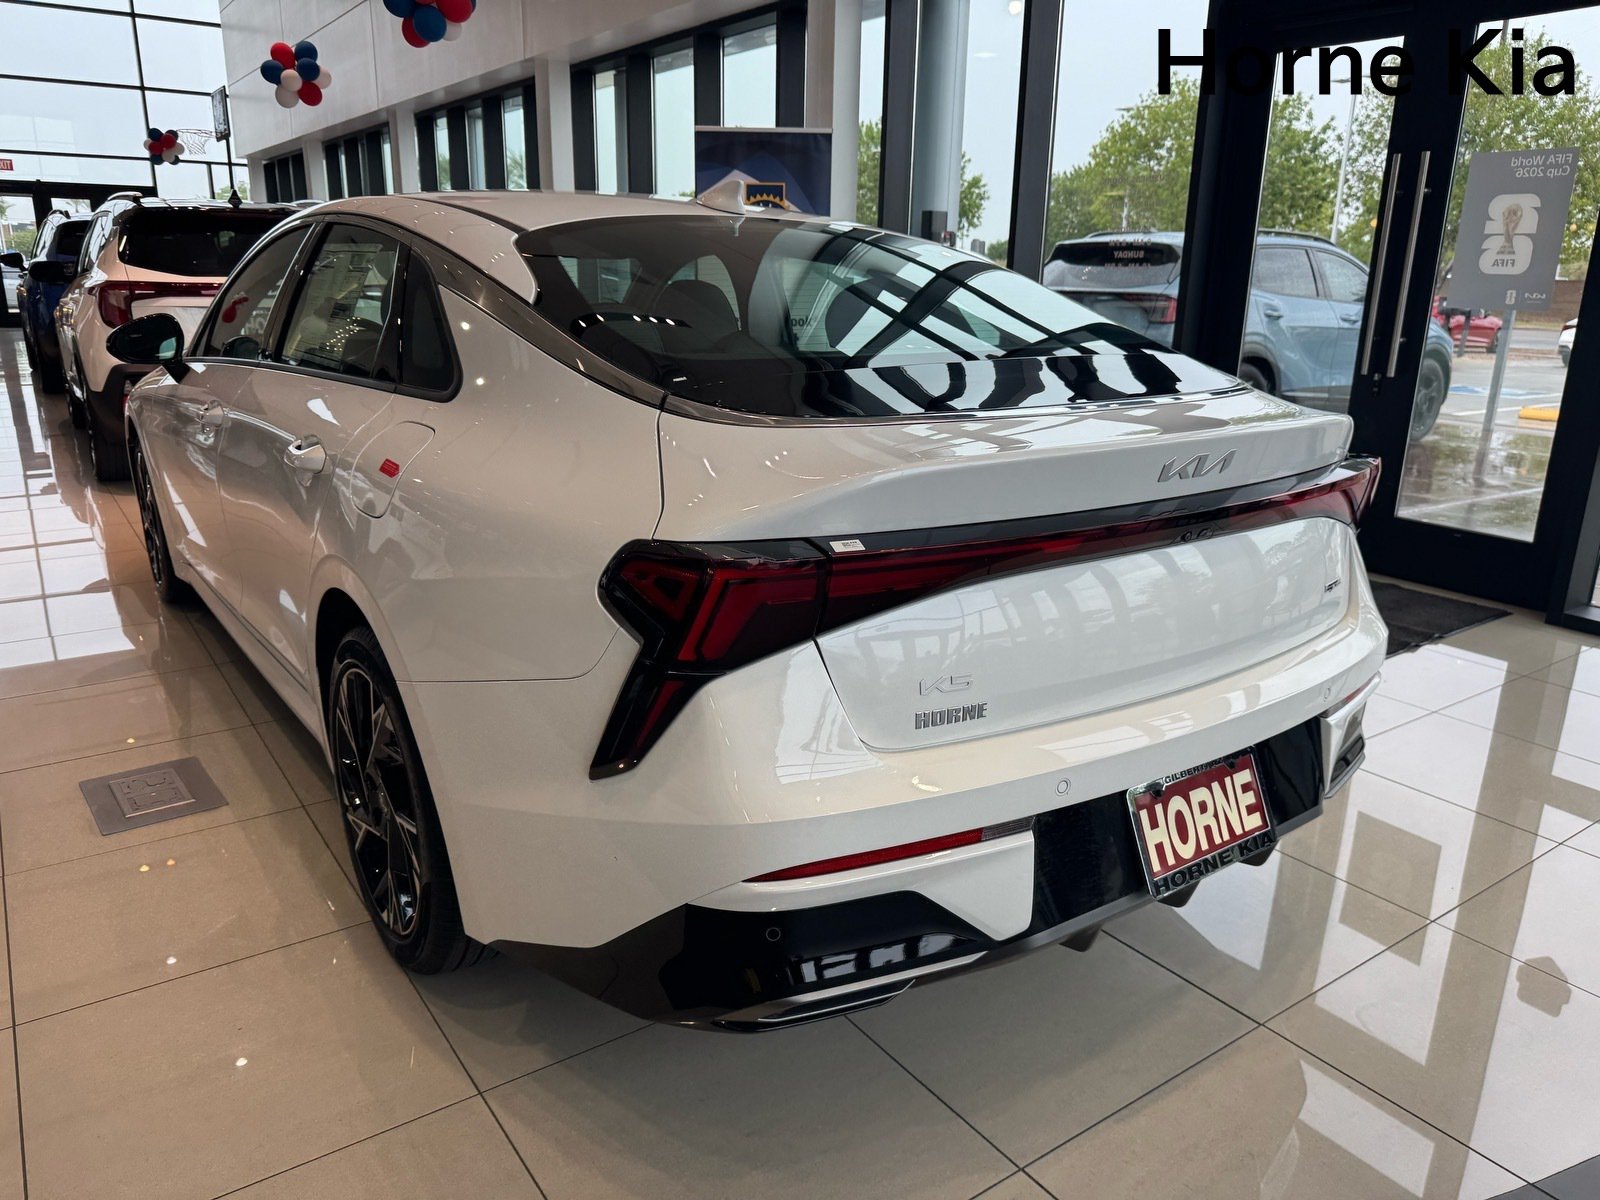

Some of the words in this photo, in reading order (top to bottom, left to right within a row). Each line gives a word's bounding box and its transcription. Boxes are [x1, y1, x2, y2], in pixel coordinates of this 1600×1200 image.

[1157, 449, 1237, 483] KIA
[919, 673, 974, 696] K5
[914, 702, 988, 730] HORNE
[1139, 768, 1262, 873] HORNE
[1153, 848, 1234, 891] HORNE
[1239, 833, 1273, 857] KIA
